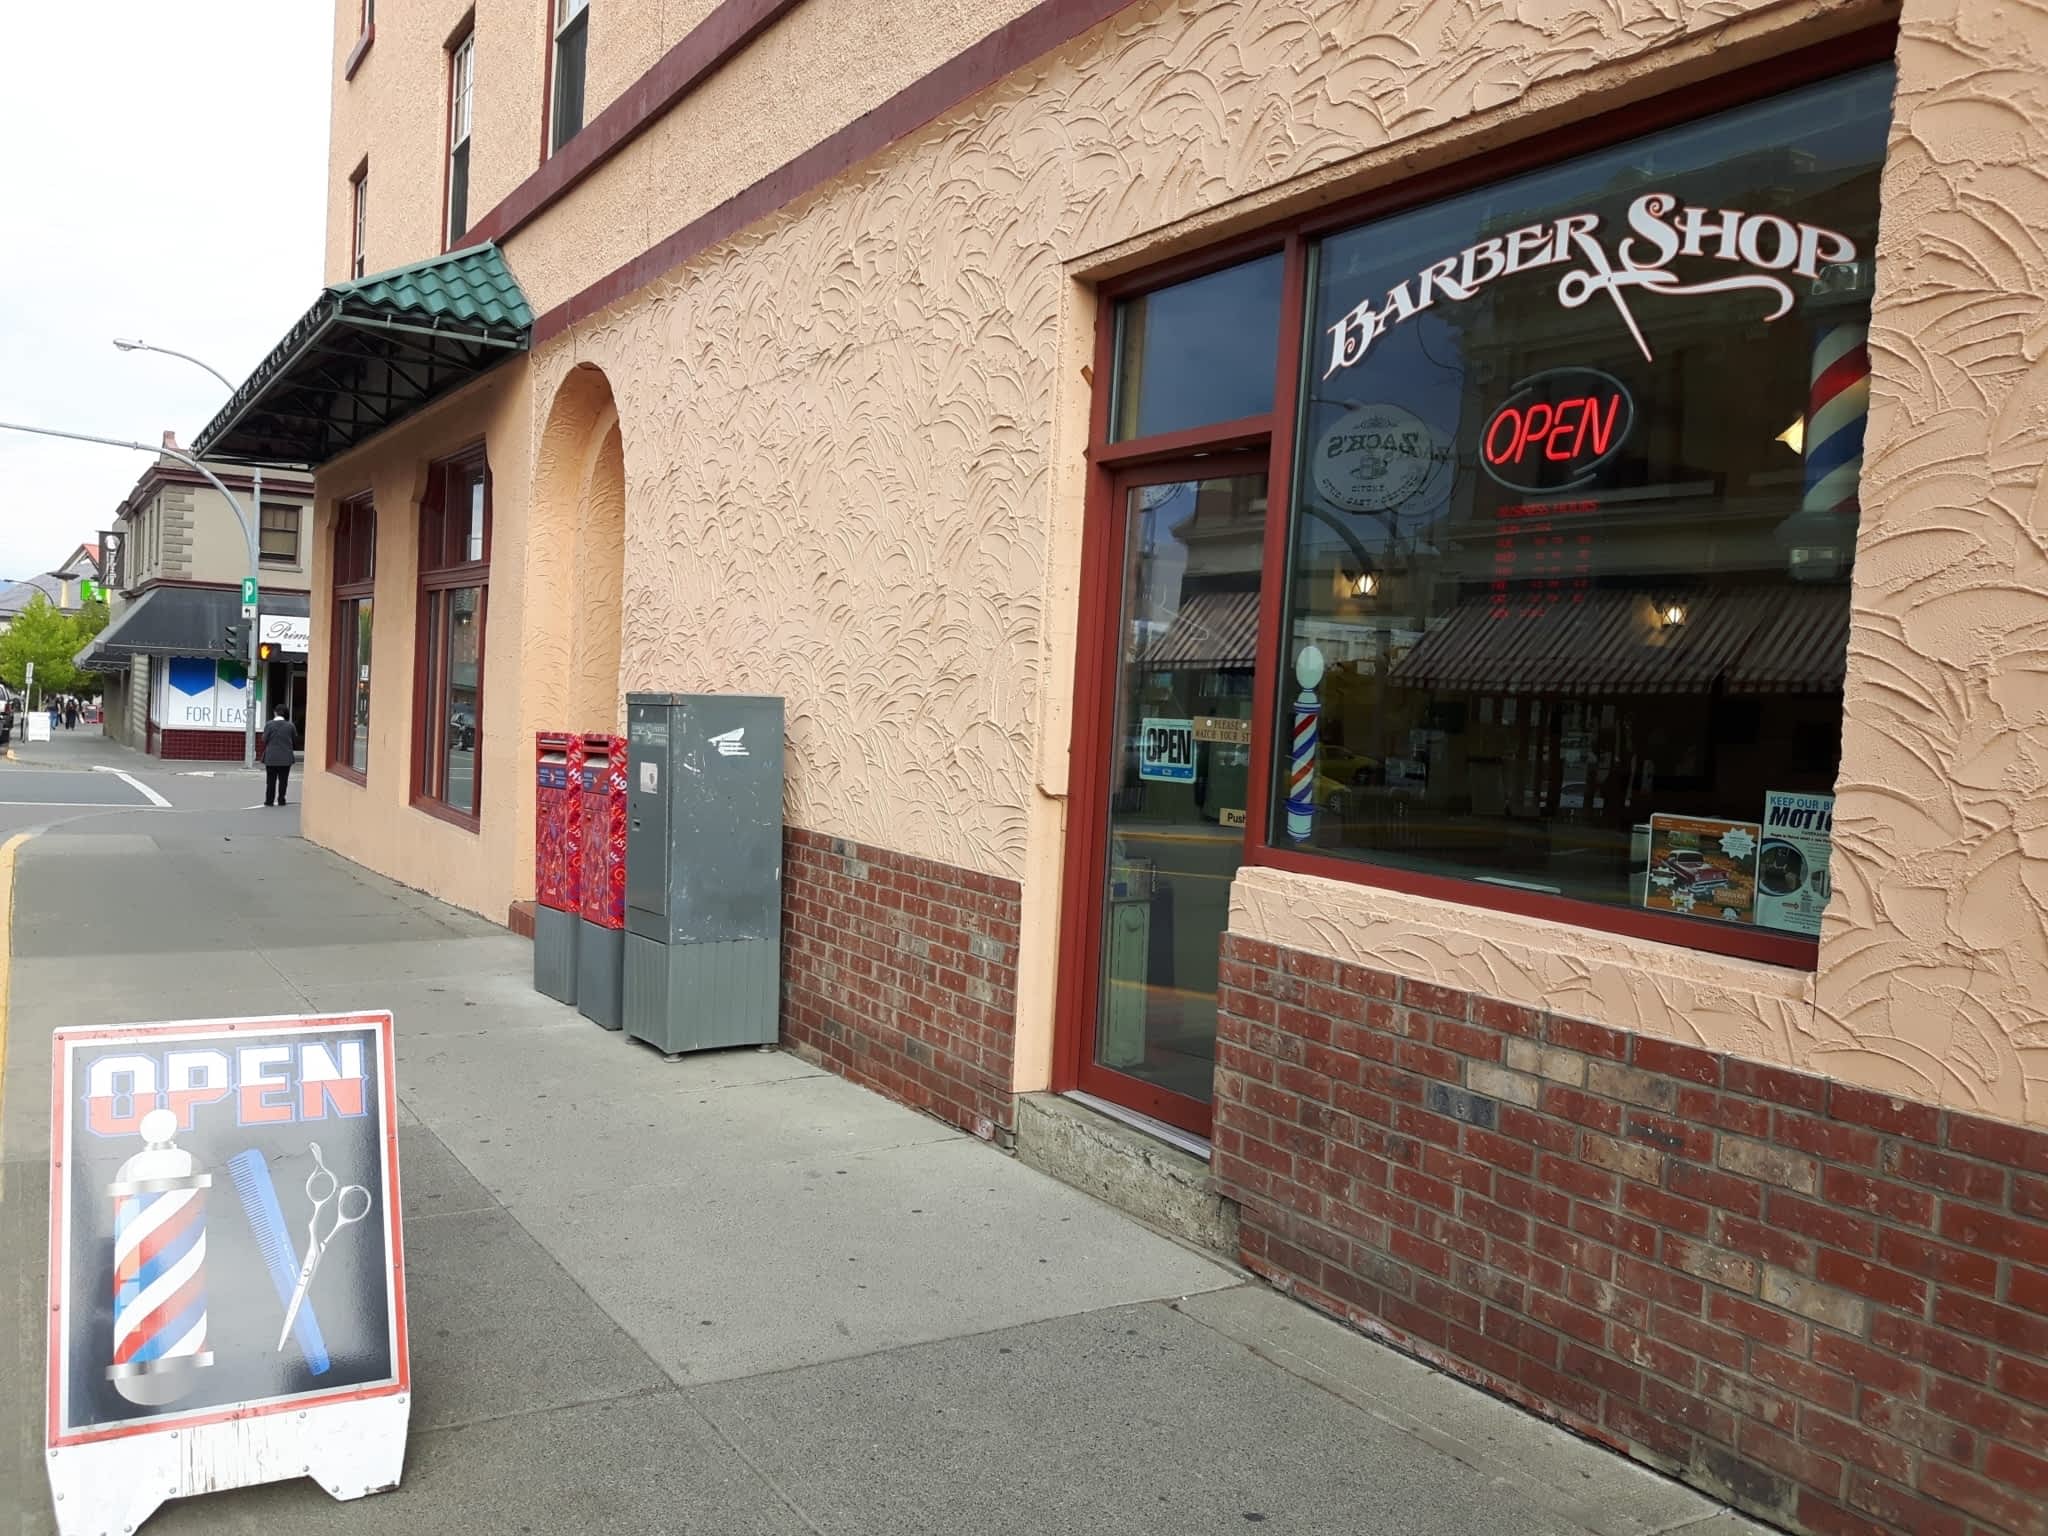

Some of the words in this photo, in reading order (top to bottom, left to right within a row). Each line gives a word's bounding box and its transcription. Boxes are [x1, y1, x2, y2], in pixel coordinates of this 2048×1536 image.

[1322, 212, 1613, 381] BARBER
[1618, 192, 1857, 279] SHOP
[1486, 393, 1620, 466] OPEN
[245, 580, 253, 602] P
[186, 706, 211, 722] FOR
[219, 707, 248, 724] LEAS
[1146, 727, 1192, 765] OPEN
[1769, 795, 1795, 807] KEEP
[1797, 798, 1819, 809] OUR
[82, 1039, 369, 1137] OPEN
